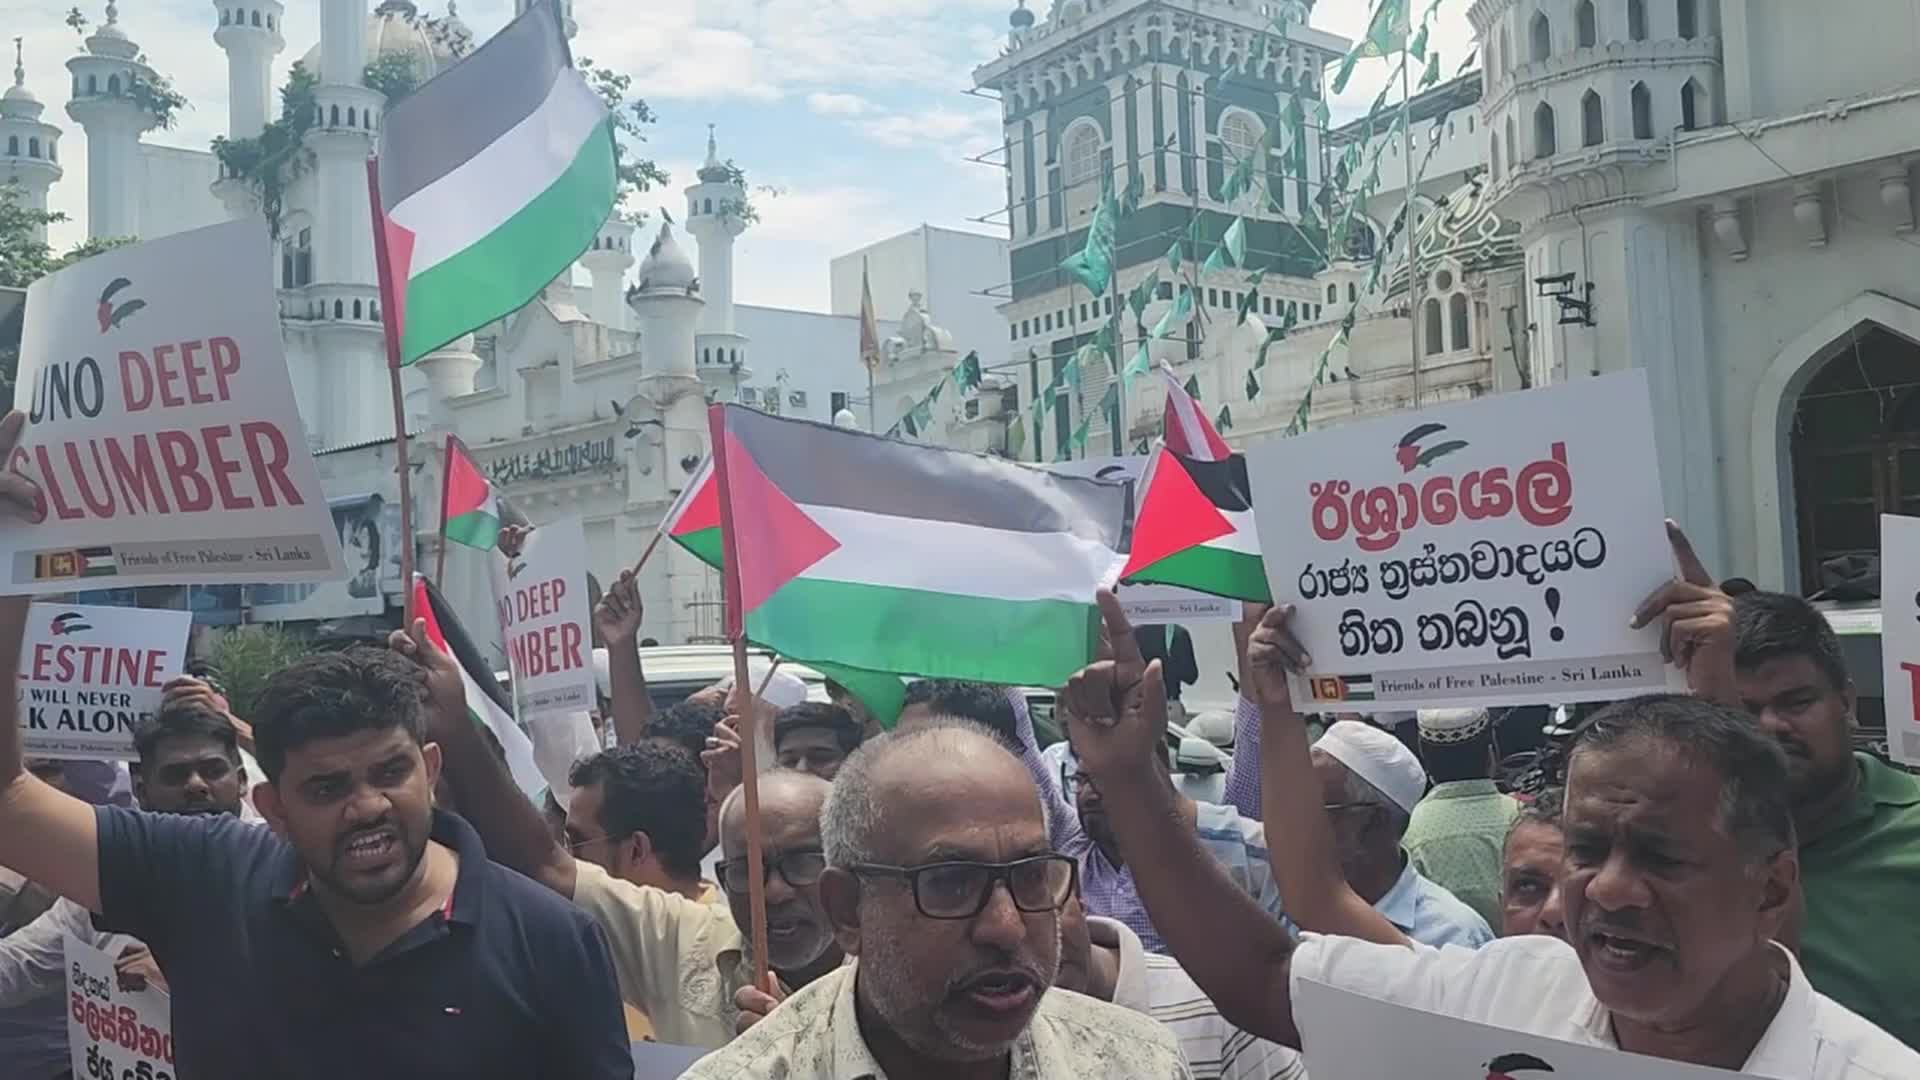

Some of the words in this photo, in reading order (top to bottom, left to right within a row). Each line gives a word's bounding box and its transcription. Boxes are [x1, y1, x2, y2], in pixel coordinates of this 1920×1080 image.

[29, 356, 104, 425] UNO
[118, 336, 241, 413] DEEP
[10, 421, 305, 524] SLUMBER
[256, 546, 273, 561] Sri
[275, 545, 312, 561] Lanka
[516, 578, 566, 622] DEEP
[1338, 608, 1404, 657] තිත
[1544, 586, 1565, 642] !
[508, 622, 584, 679] MBER
[30, 688, 70, 705] WILL
[77, 691, 131, 708] NEVER
[1380, 678, 1425, 693] Friends
[1428, 676, 1443, 690] of
[1445, 675, 1475, 688] Free
[1480, 671, 1545, 687] Palestine
[1561, 668, 1585, 682] Sri
[1591, 664, 1642, 680] Lanka
